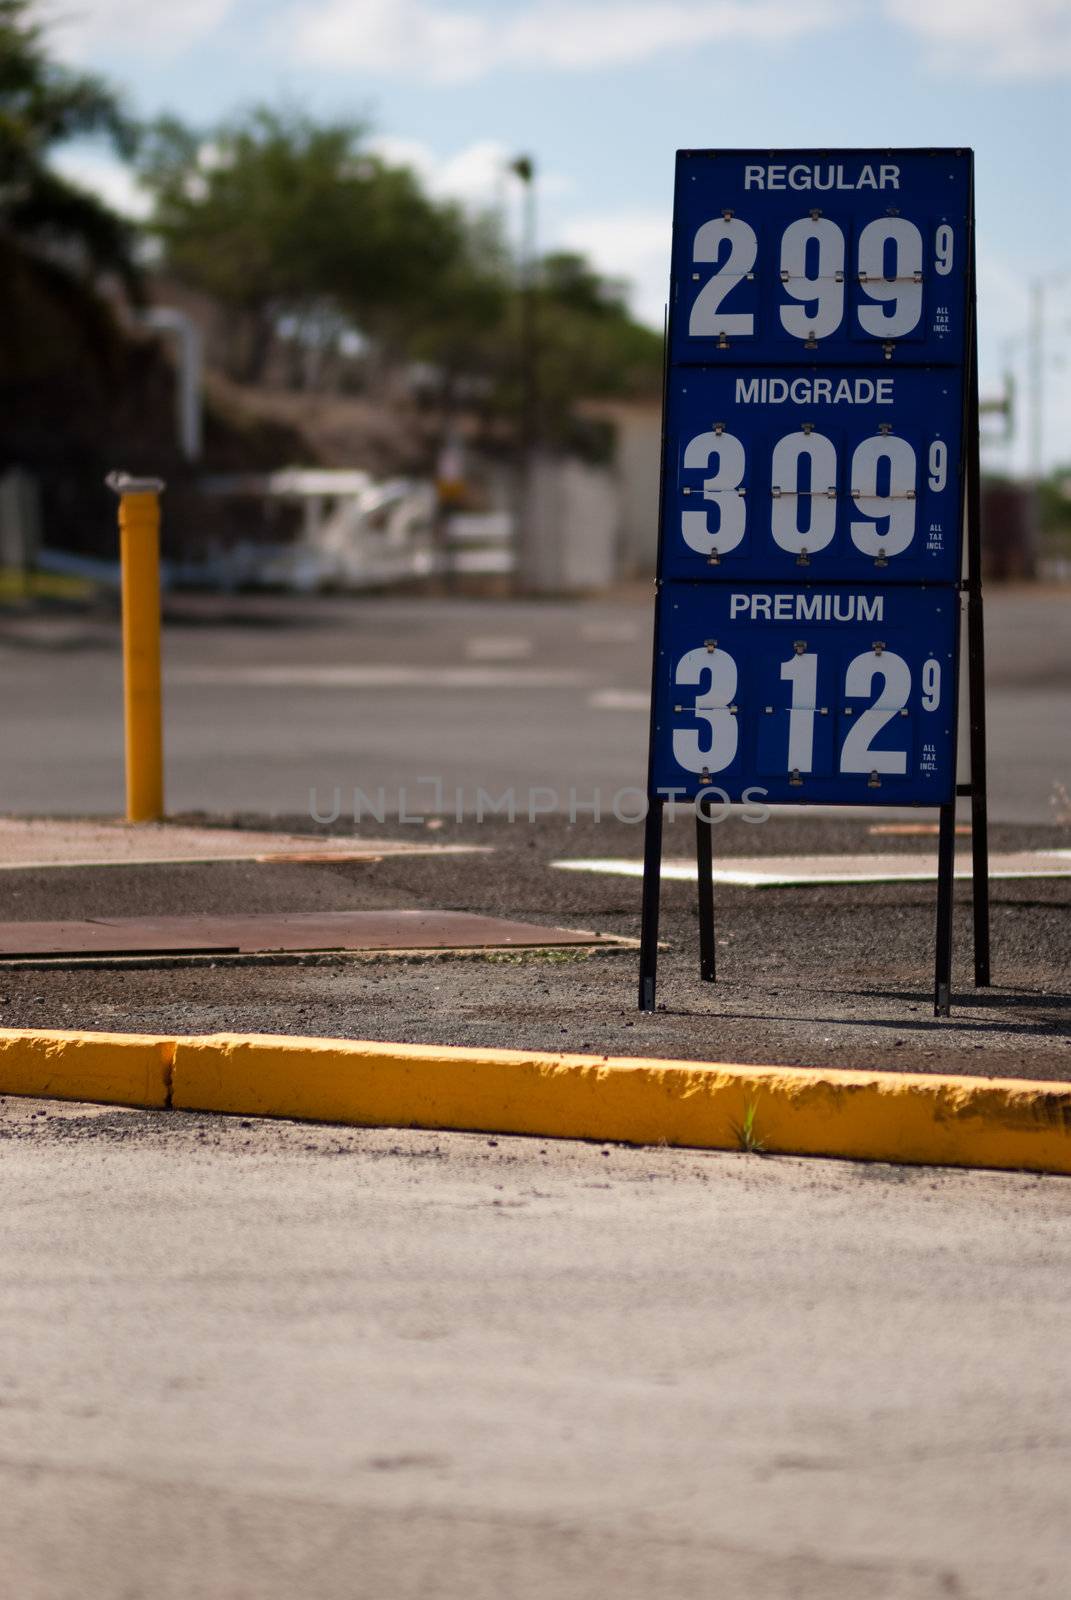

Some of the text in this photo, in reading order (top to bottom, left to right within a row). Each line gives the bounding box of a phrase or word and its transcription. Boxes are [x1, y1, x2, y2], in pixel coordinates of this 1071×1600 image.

[744, 165, 900, 190] REGULAR
[735, 378, 894, 404] MIDGRADE
[730, 594, 884, 621] PREMIUM
[922, 753, 936, 761] TAX
[923, 744, 936, 752] ALL
